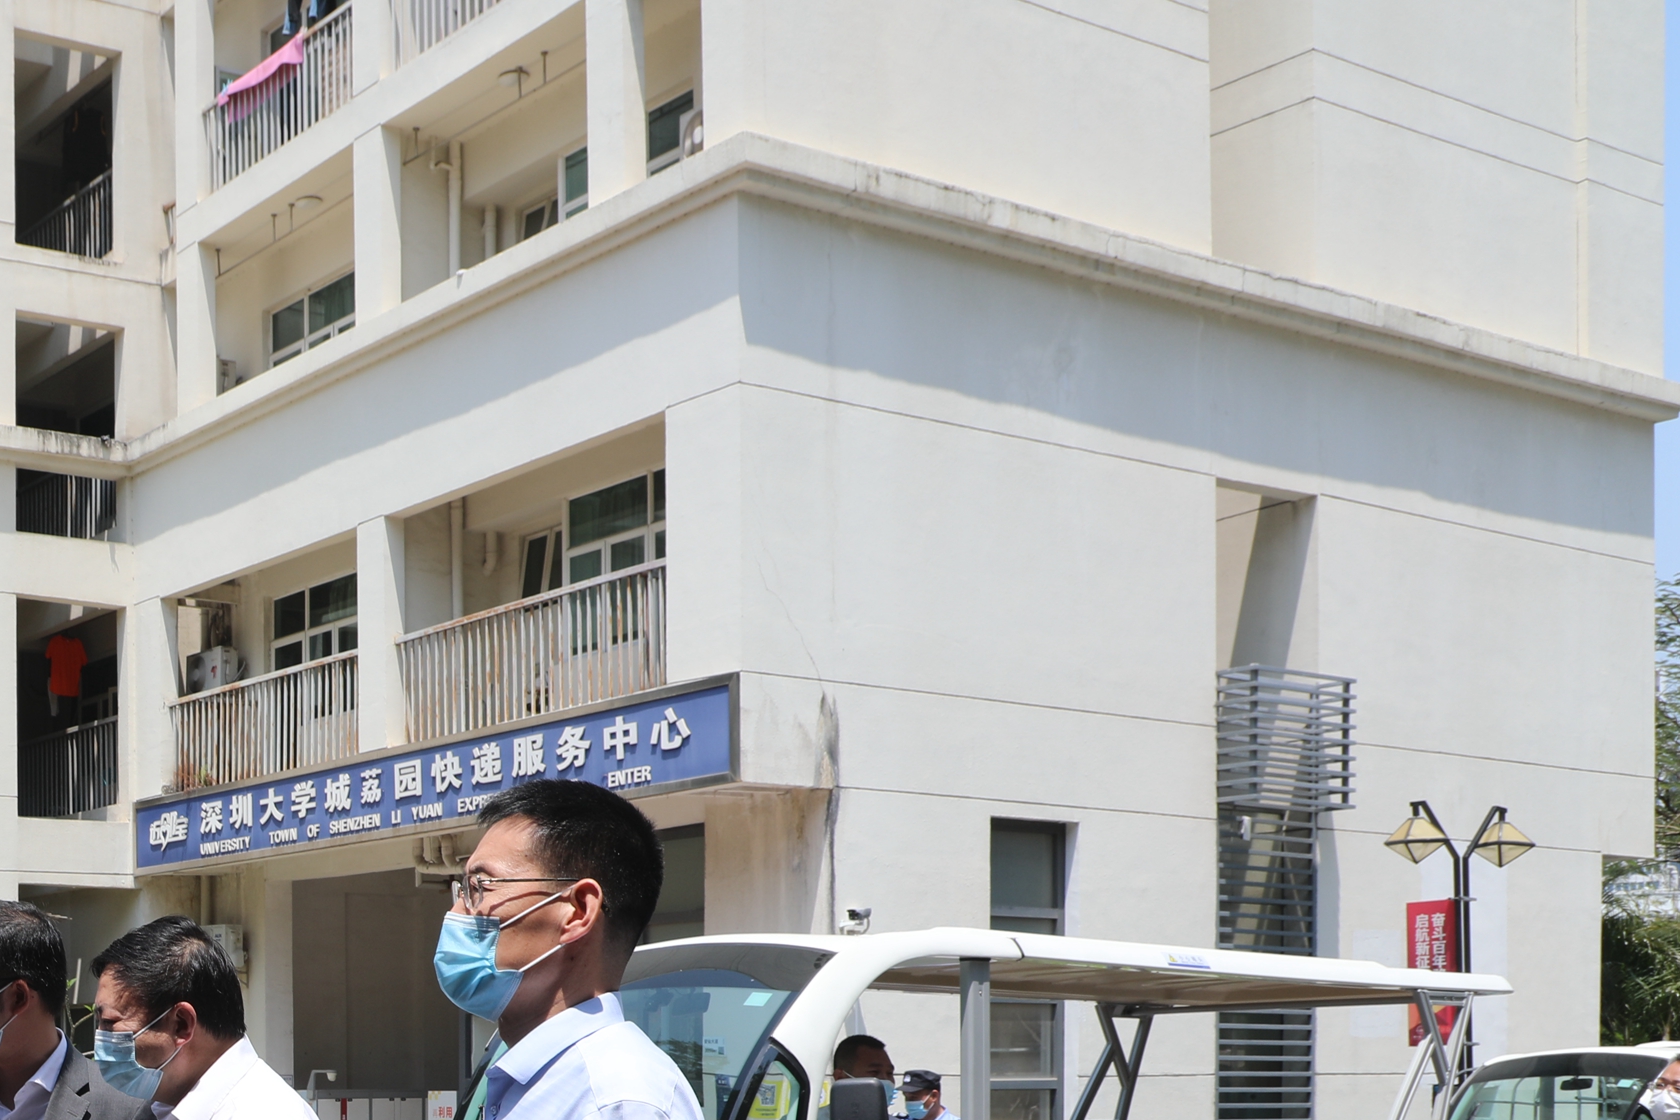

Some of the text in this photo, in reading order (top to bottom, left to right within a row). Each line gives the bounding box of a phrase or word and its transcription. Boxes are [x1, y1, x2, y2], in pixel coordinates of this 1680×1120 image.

[200, 707, 691, 834] 深圳大学城荔园快递服务中心
[200, 836, 251, 855] UNIVERSITY
[269, 827, 298, 844] TOWN
[307, 824, 320, 838] OF
[329, 813, 381, 834] SHENZHEN
[391, 810, 401, 825] LI
[412, 802, 443, 820] YUAN
[1431, 912, 1447, 972] 奋斗百年
